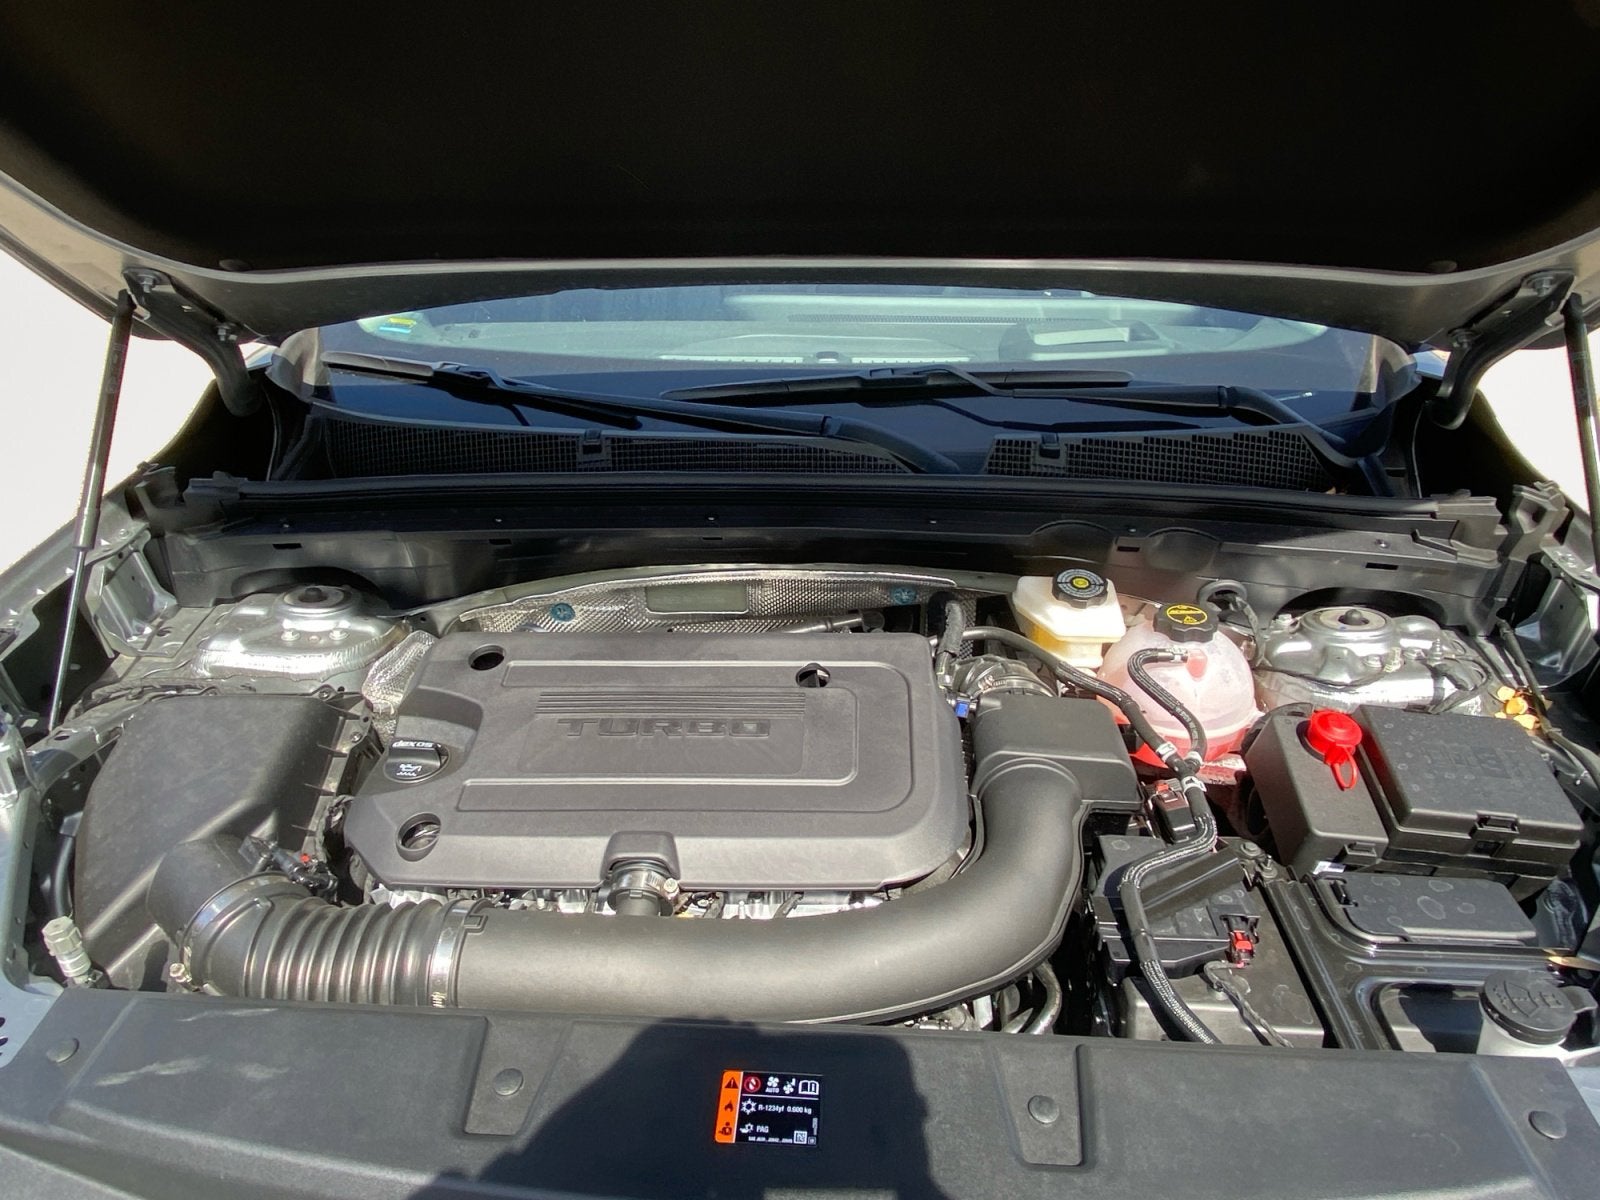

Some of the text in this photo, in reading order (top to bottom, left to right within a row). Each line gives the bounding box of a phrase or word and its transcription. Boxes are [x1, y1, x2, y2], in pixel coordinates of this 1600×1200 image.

[557, 718, 770, 738] TURBO
[758, 1104, 784, 1113] R-1234yf
[756, 1125, 769, 1133] PAG
